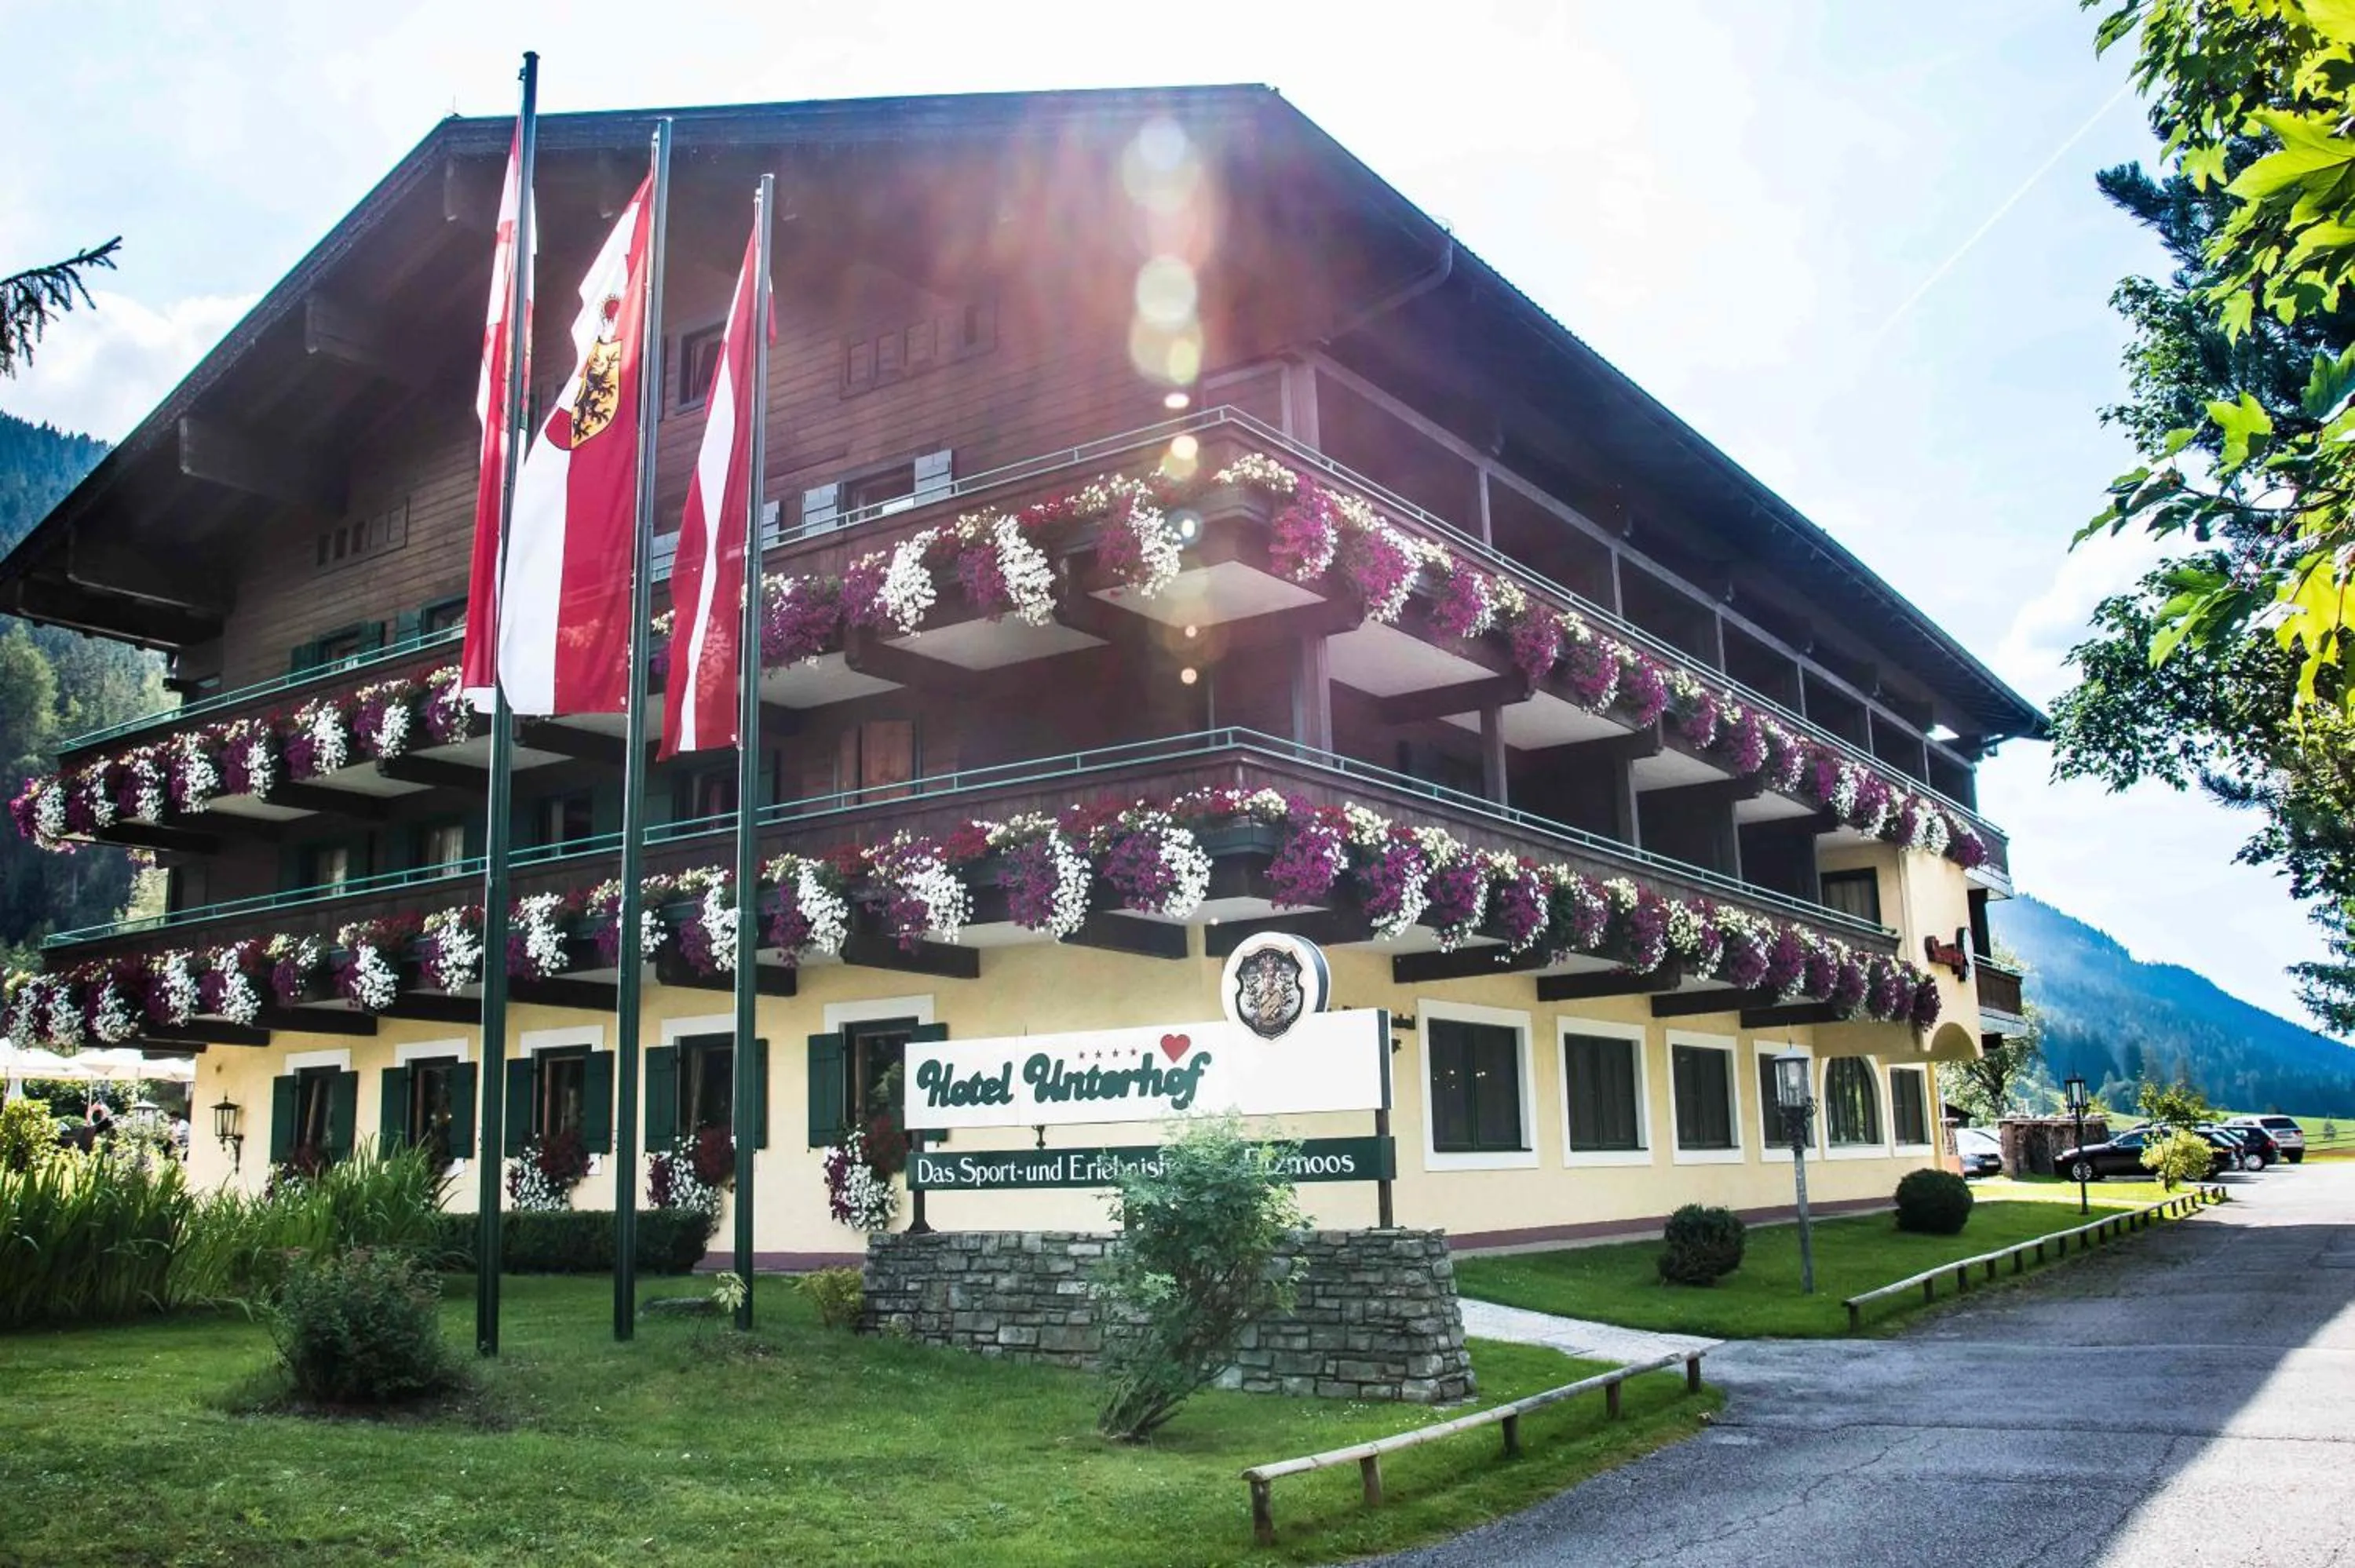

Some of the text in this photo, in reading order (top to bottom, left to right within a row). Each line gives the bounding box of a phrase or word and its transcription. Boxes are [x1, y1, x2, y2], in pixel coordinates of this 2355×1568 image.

[916, 1051, 1212, 1110] Hotel Unterhof
[917, 1158, 955, 1183] Das
